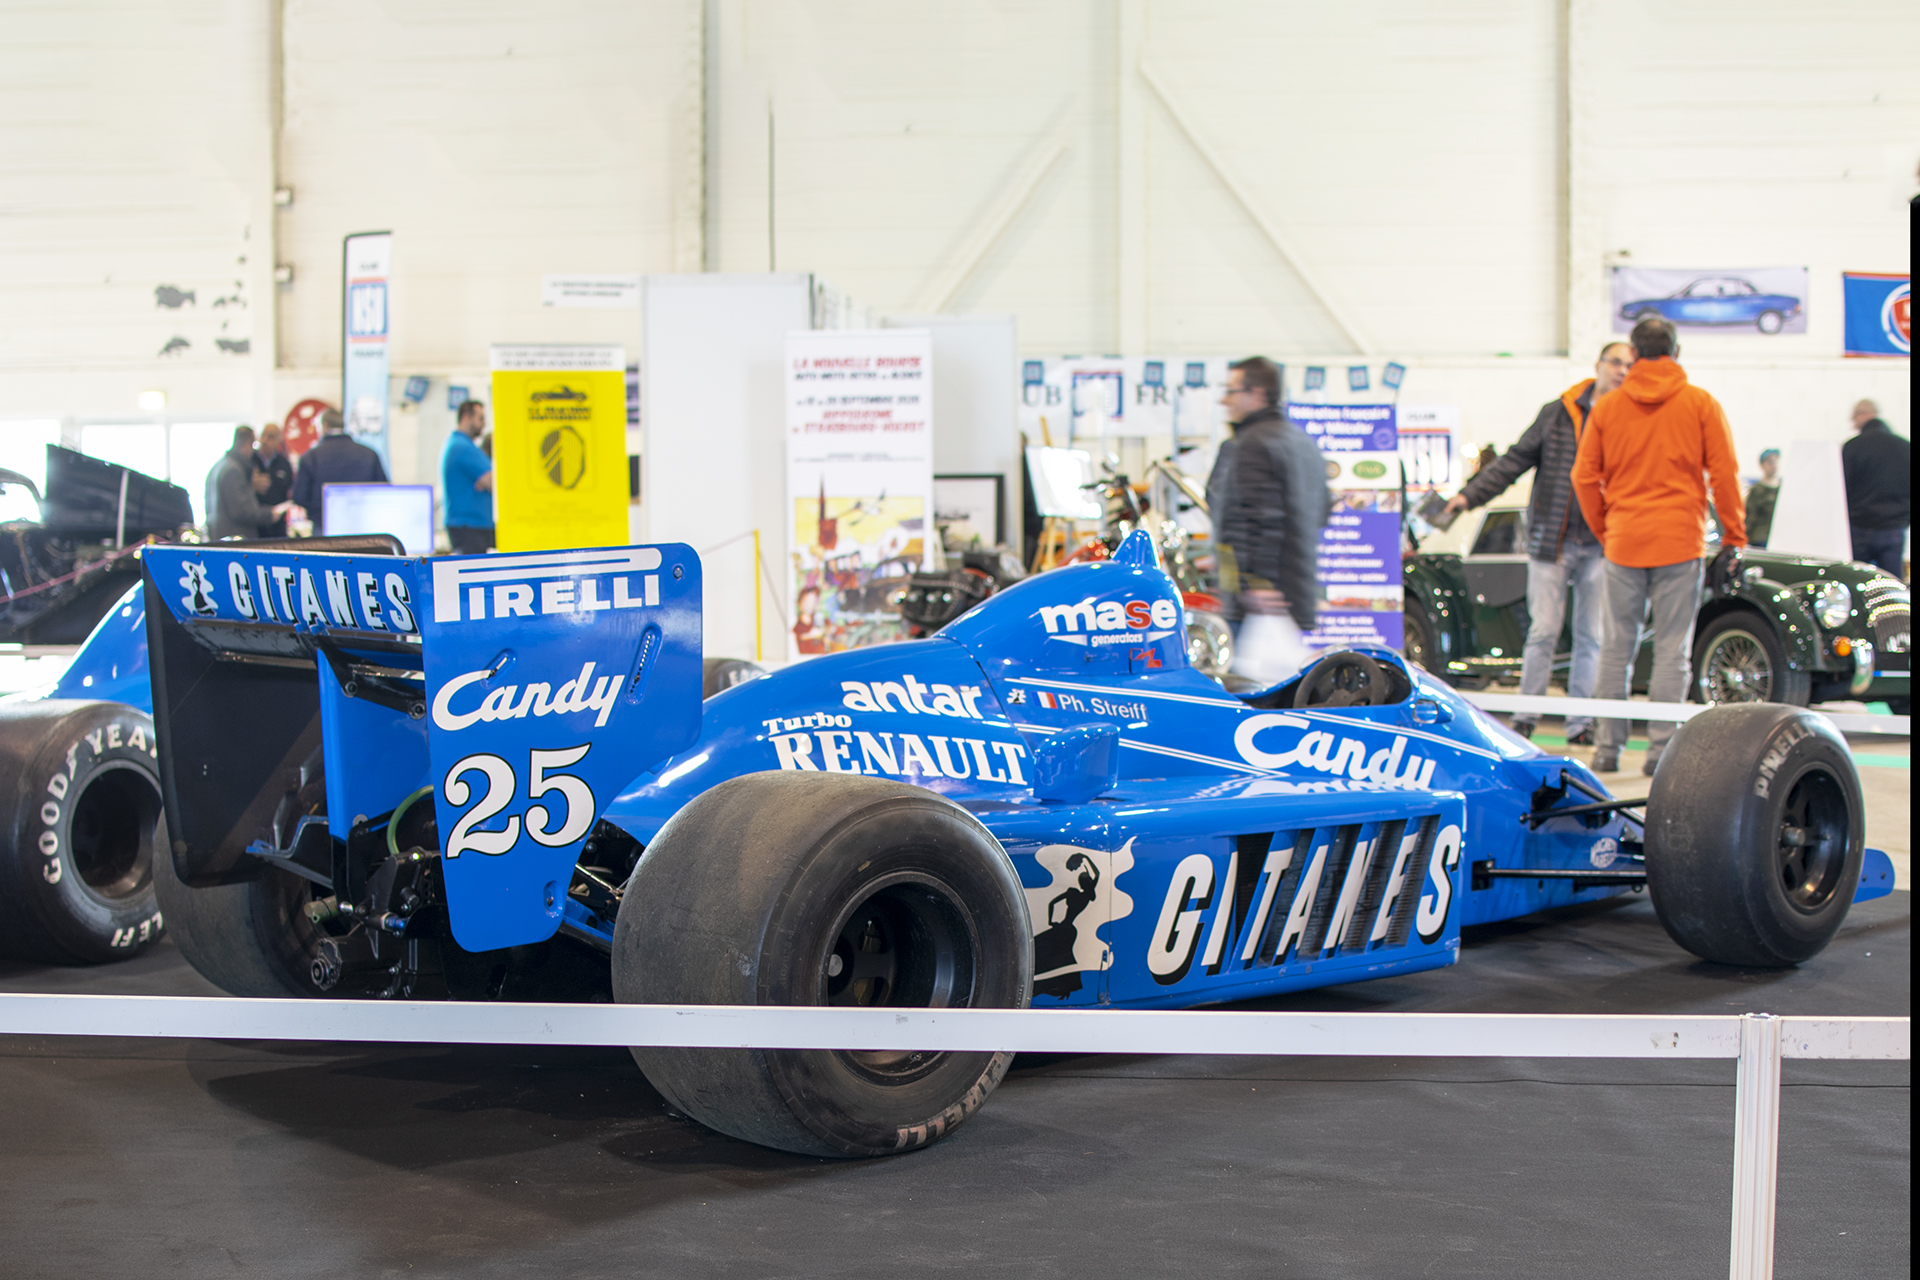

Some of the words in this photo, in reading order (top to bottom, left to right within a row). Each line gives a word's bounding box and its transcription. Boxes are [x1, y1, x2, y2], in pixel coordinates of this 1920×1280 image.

[228, 561, 420, 635] GITANES
[432, 548, 662, 623] PIRELLI
[1039, 599, 1177, 633] mase
[1091, 632, 1143, 647] generators
[432, 661, 625, 731] Candy
[762, 711, 852, 736] Turbo
[840, 674, 983, 719] antar
[1058, 693, 1090, 713] Ph.
[1093, 696, 1147, 720] Streiff
[768, 730, 1028, 786] RENAULT
[1234, 713, 1437, 790] Candy
[1753, 721, 1817, 800] PIRELLI
[443, 741, 596, 860] 25
[1147, 824, 1464, 985] GITANES
